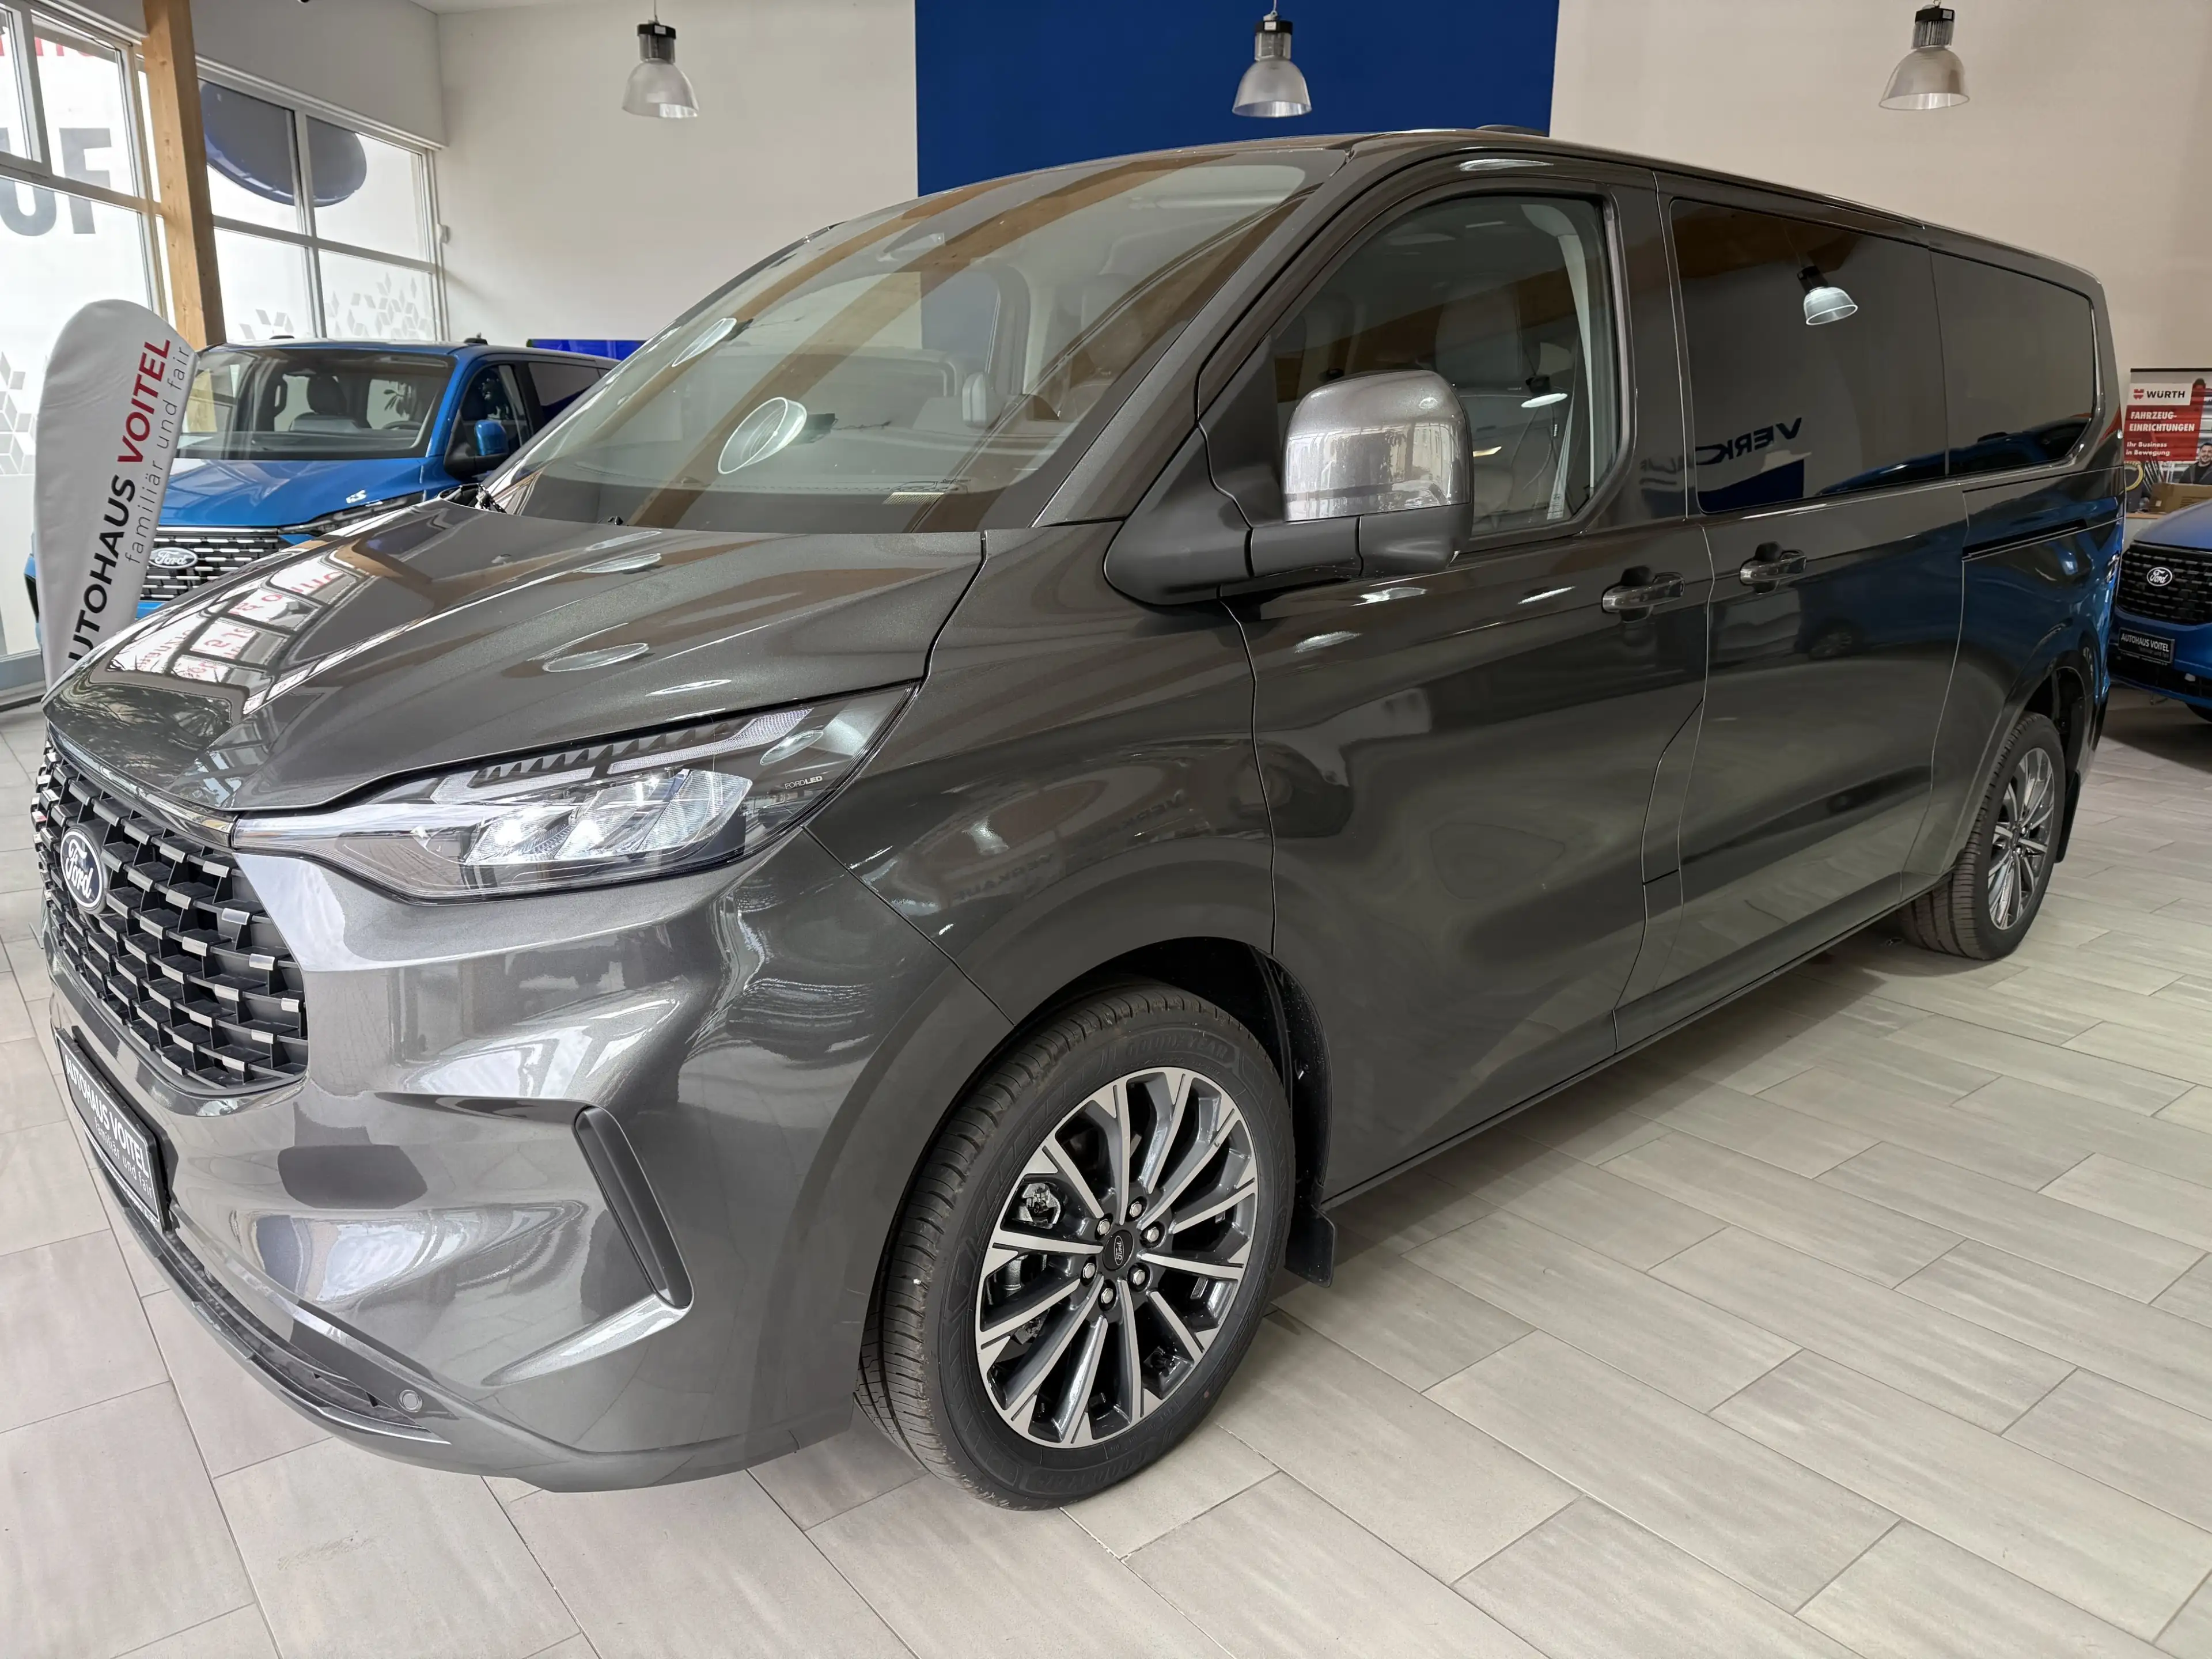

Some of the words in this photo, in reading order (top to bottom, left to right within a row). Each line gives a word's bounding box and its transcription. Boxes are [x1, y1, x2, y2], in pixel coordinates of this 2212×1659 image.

[167, 346, 190, 391] fair
[2130, 411, 2177, 420] FAHRZEUG-
[2146, 390, 2186, 399] WÜRTH
[157, 399, 178, 449] und
[2129, 423, 2195, 432] EINRICHTUNGEN
[64, 474, 136, 673] UTOHAUS
[117, 339, 171, 463] VOITEL
[125, 460, 164, 563] familiär
[2150, 569, 2168, 584] Ford
[2120, 632, 2150, 648] AUTOHAUS
[2150, 639, 2170, 653] VOITEL
[65, 839, 94, 899] Ford
[65, 1054, 110, 1131] AUTOHAUS
[109, 1111, 150, 1179] VOITEL
[122, 1157, 137, 1180] und
[138, 1170, 153, 1199] fair
